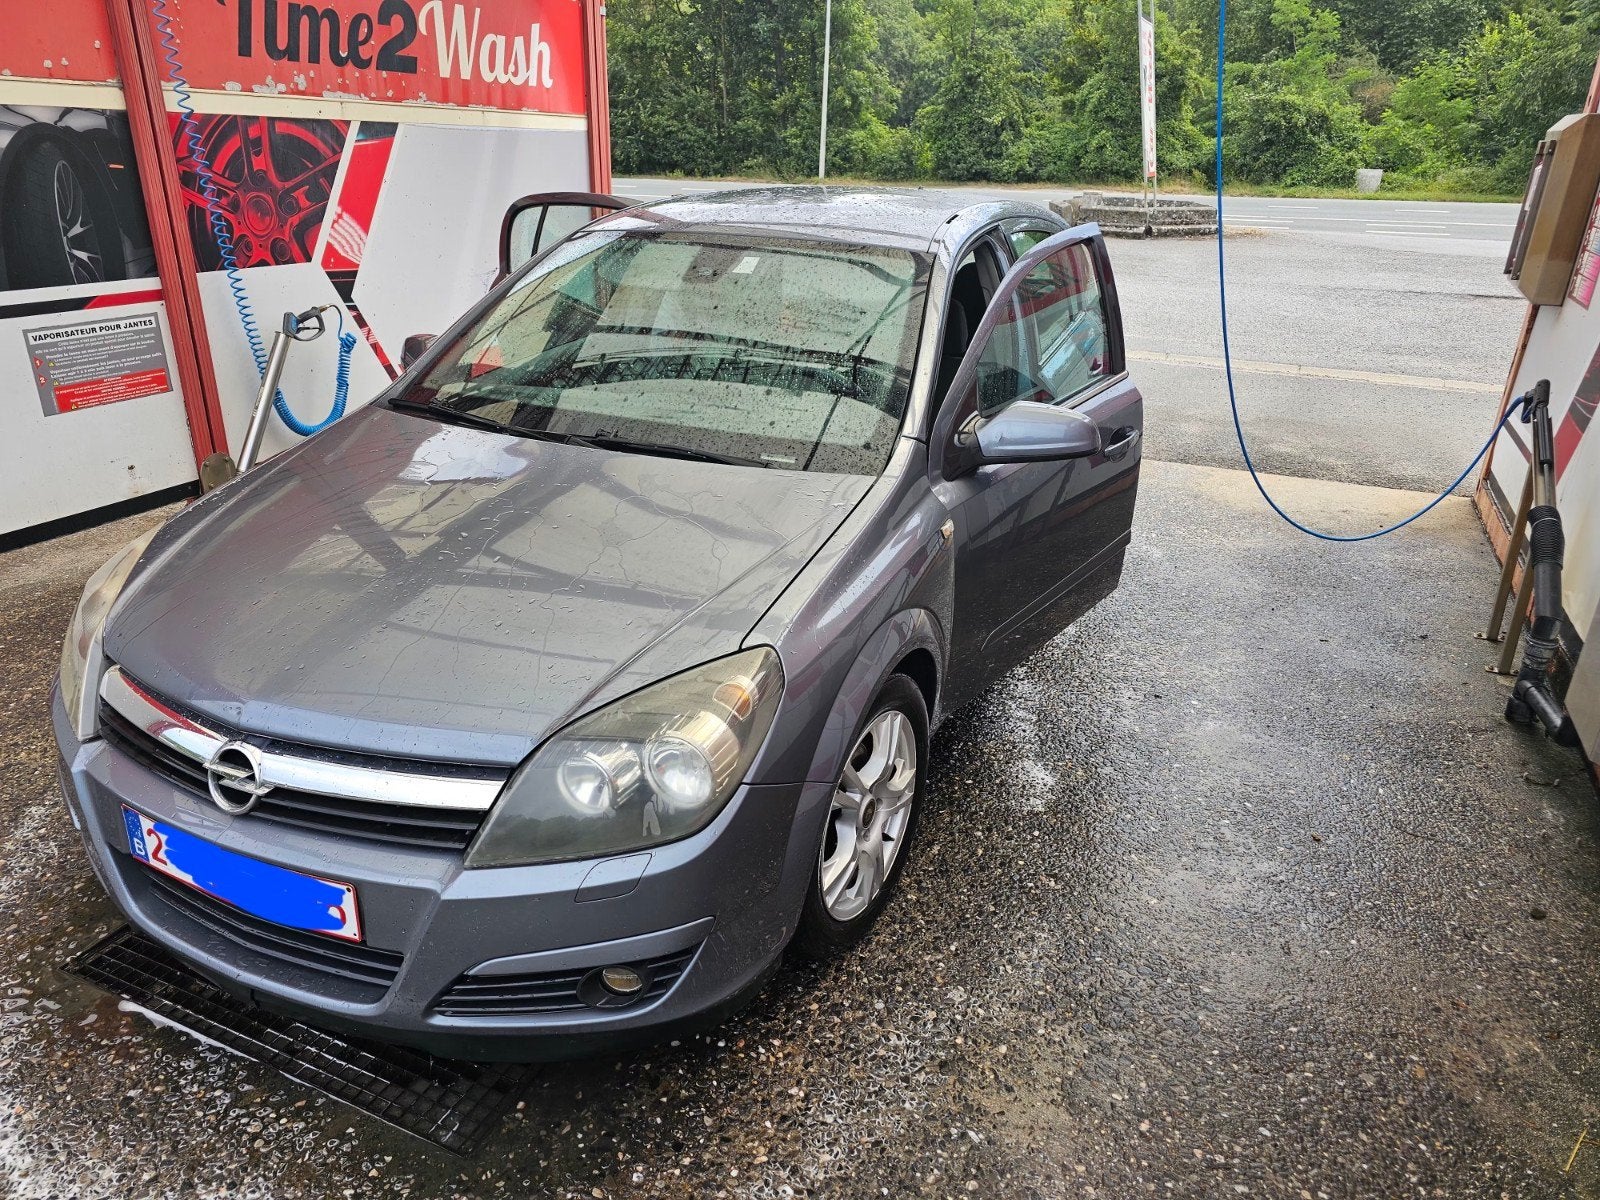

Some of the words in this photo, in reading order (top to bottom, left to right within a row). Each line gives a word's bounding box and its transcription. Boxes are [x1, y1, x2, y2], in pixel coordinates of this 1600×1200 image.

[32, 327, 97, 342] VAPORISATEUR
[99, 324, 122, 333] POUR
[123, 319, 153, 329] JANTES
[134, 837, 145, 856] B
